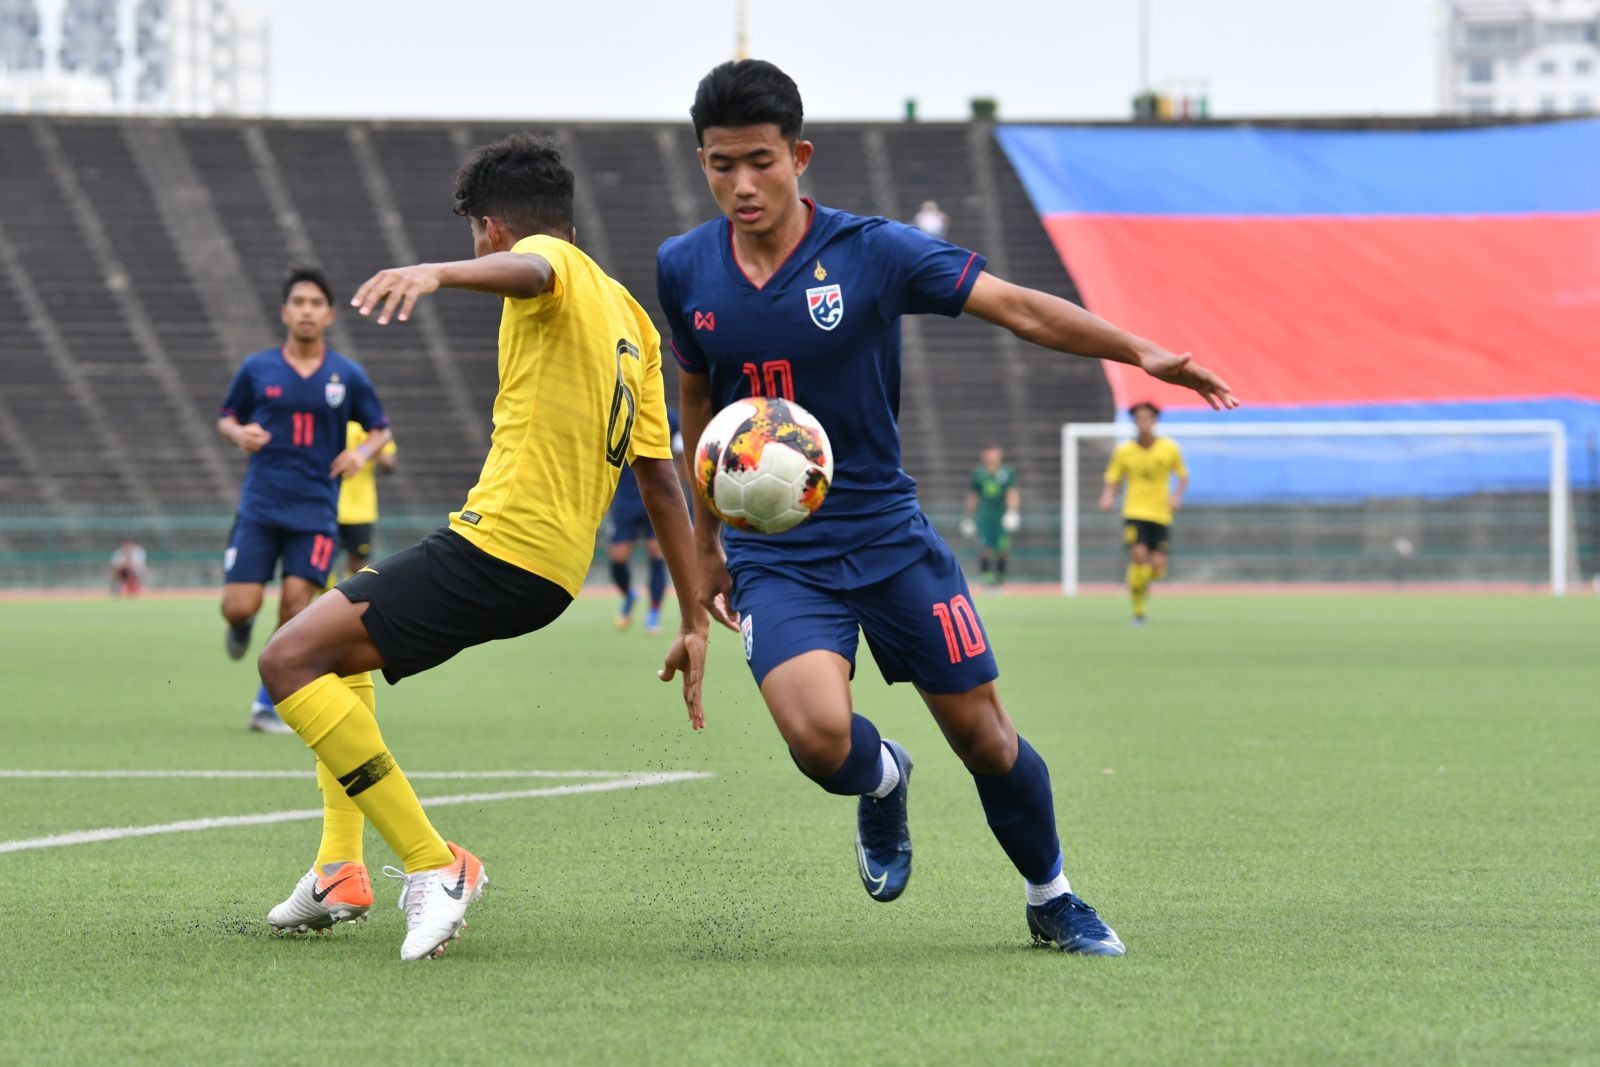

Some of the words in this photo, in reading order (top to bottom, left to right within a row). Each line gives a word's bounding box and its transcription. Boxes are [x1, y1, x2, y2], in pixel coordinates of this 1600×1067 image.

[292, 412, 314, 446] 11
[606, 338, 640, 468] 6
[310, 534, 334, 571] 11
[932, 593, 986, 664] 10
